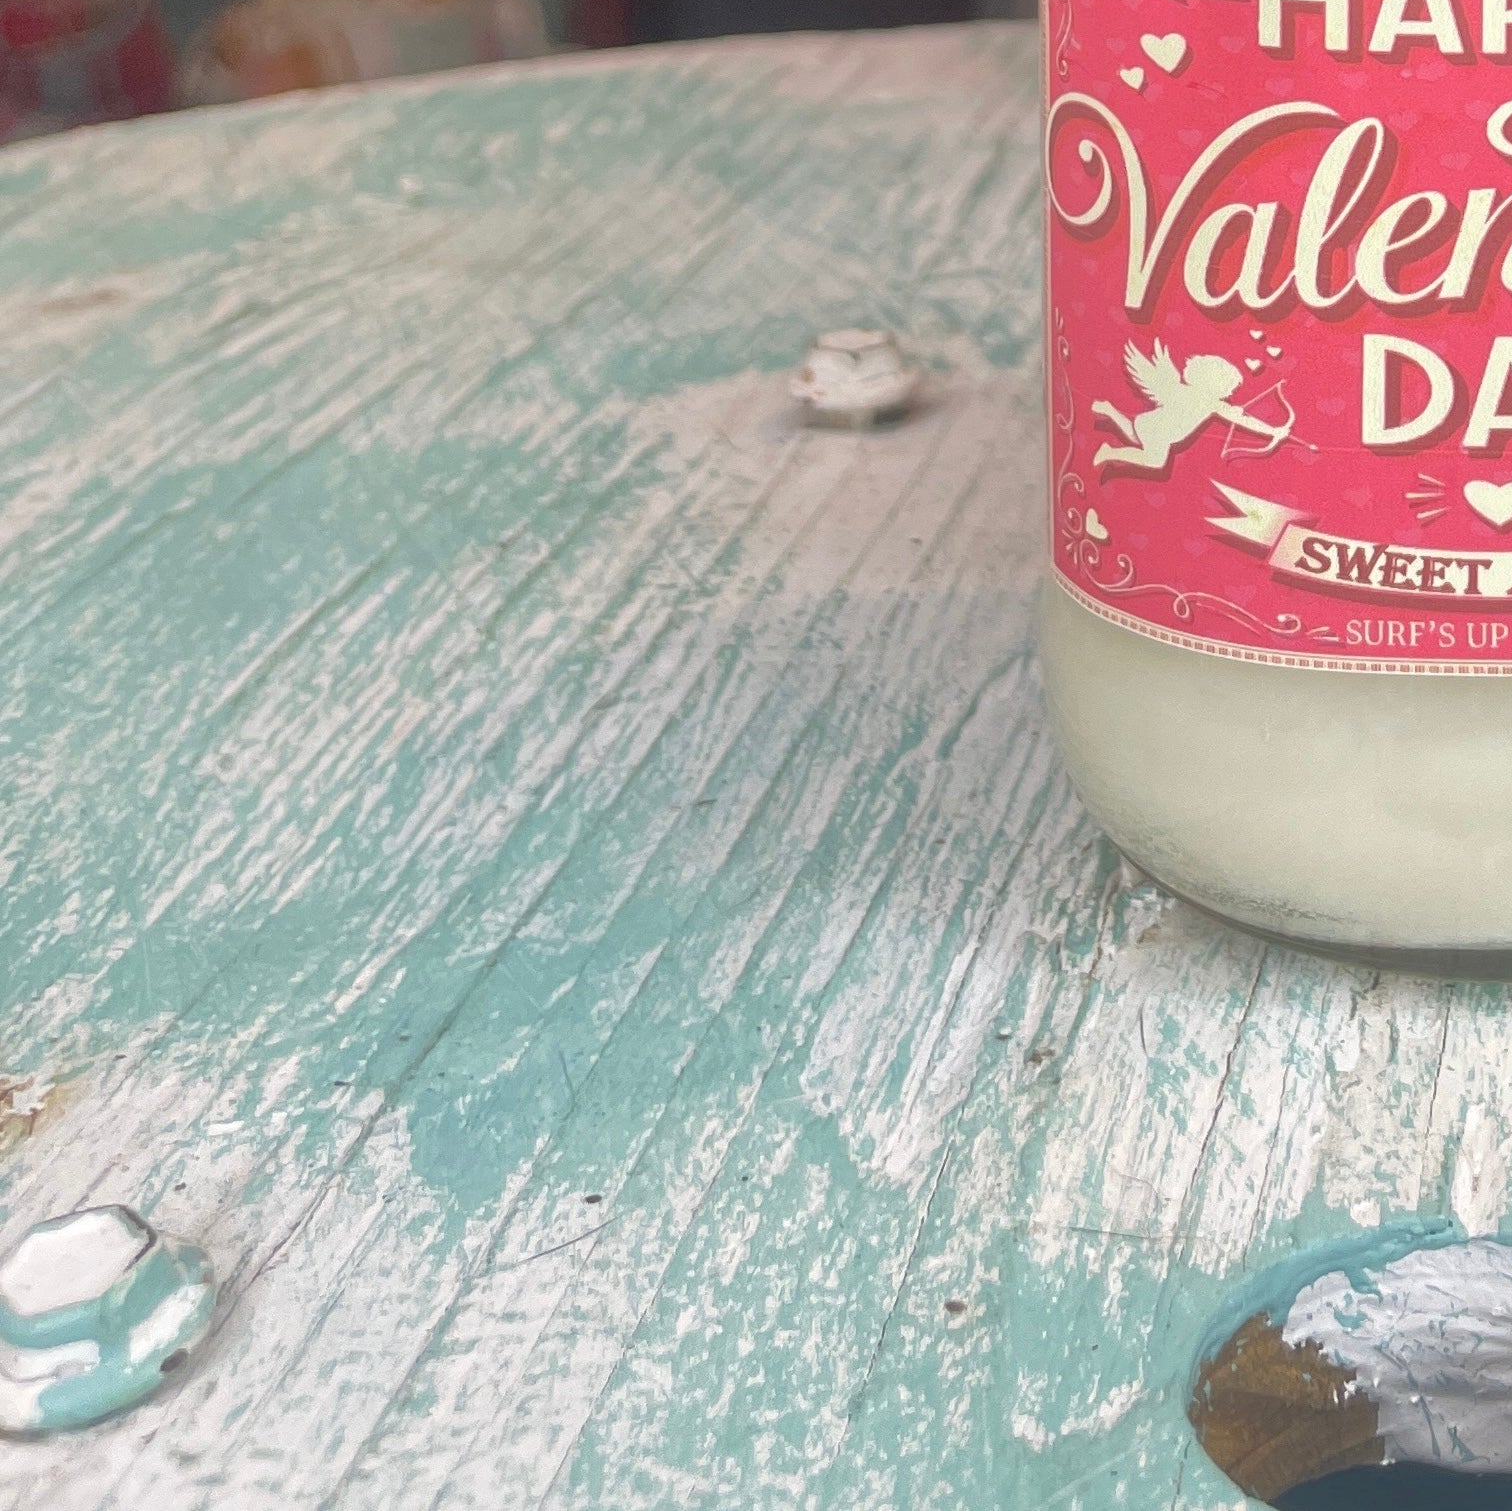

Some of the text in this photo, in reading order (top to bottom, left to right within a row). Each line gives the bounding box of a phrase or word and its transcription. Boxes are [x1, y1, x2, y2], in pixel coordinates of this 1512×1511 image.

[1294, 535, 1494, 595] SWEET
[1345, 619, 1456, 649] SURF'S
[1466, 621, 1508, 649] UP
